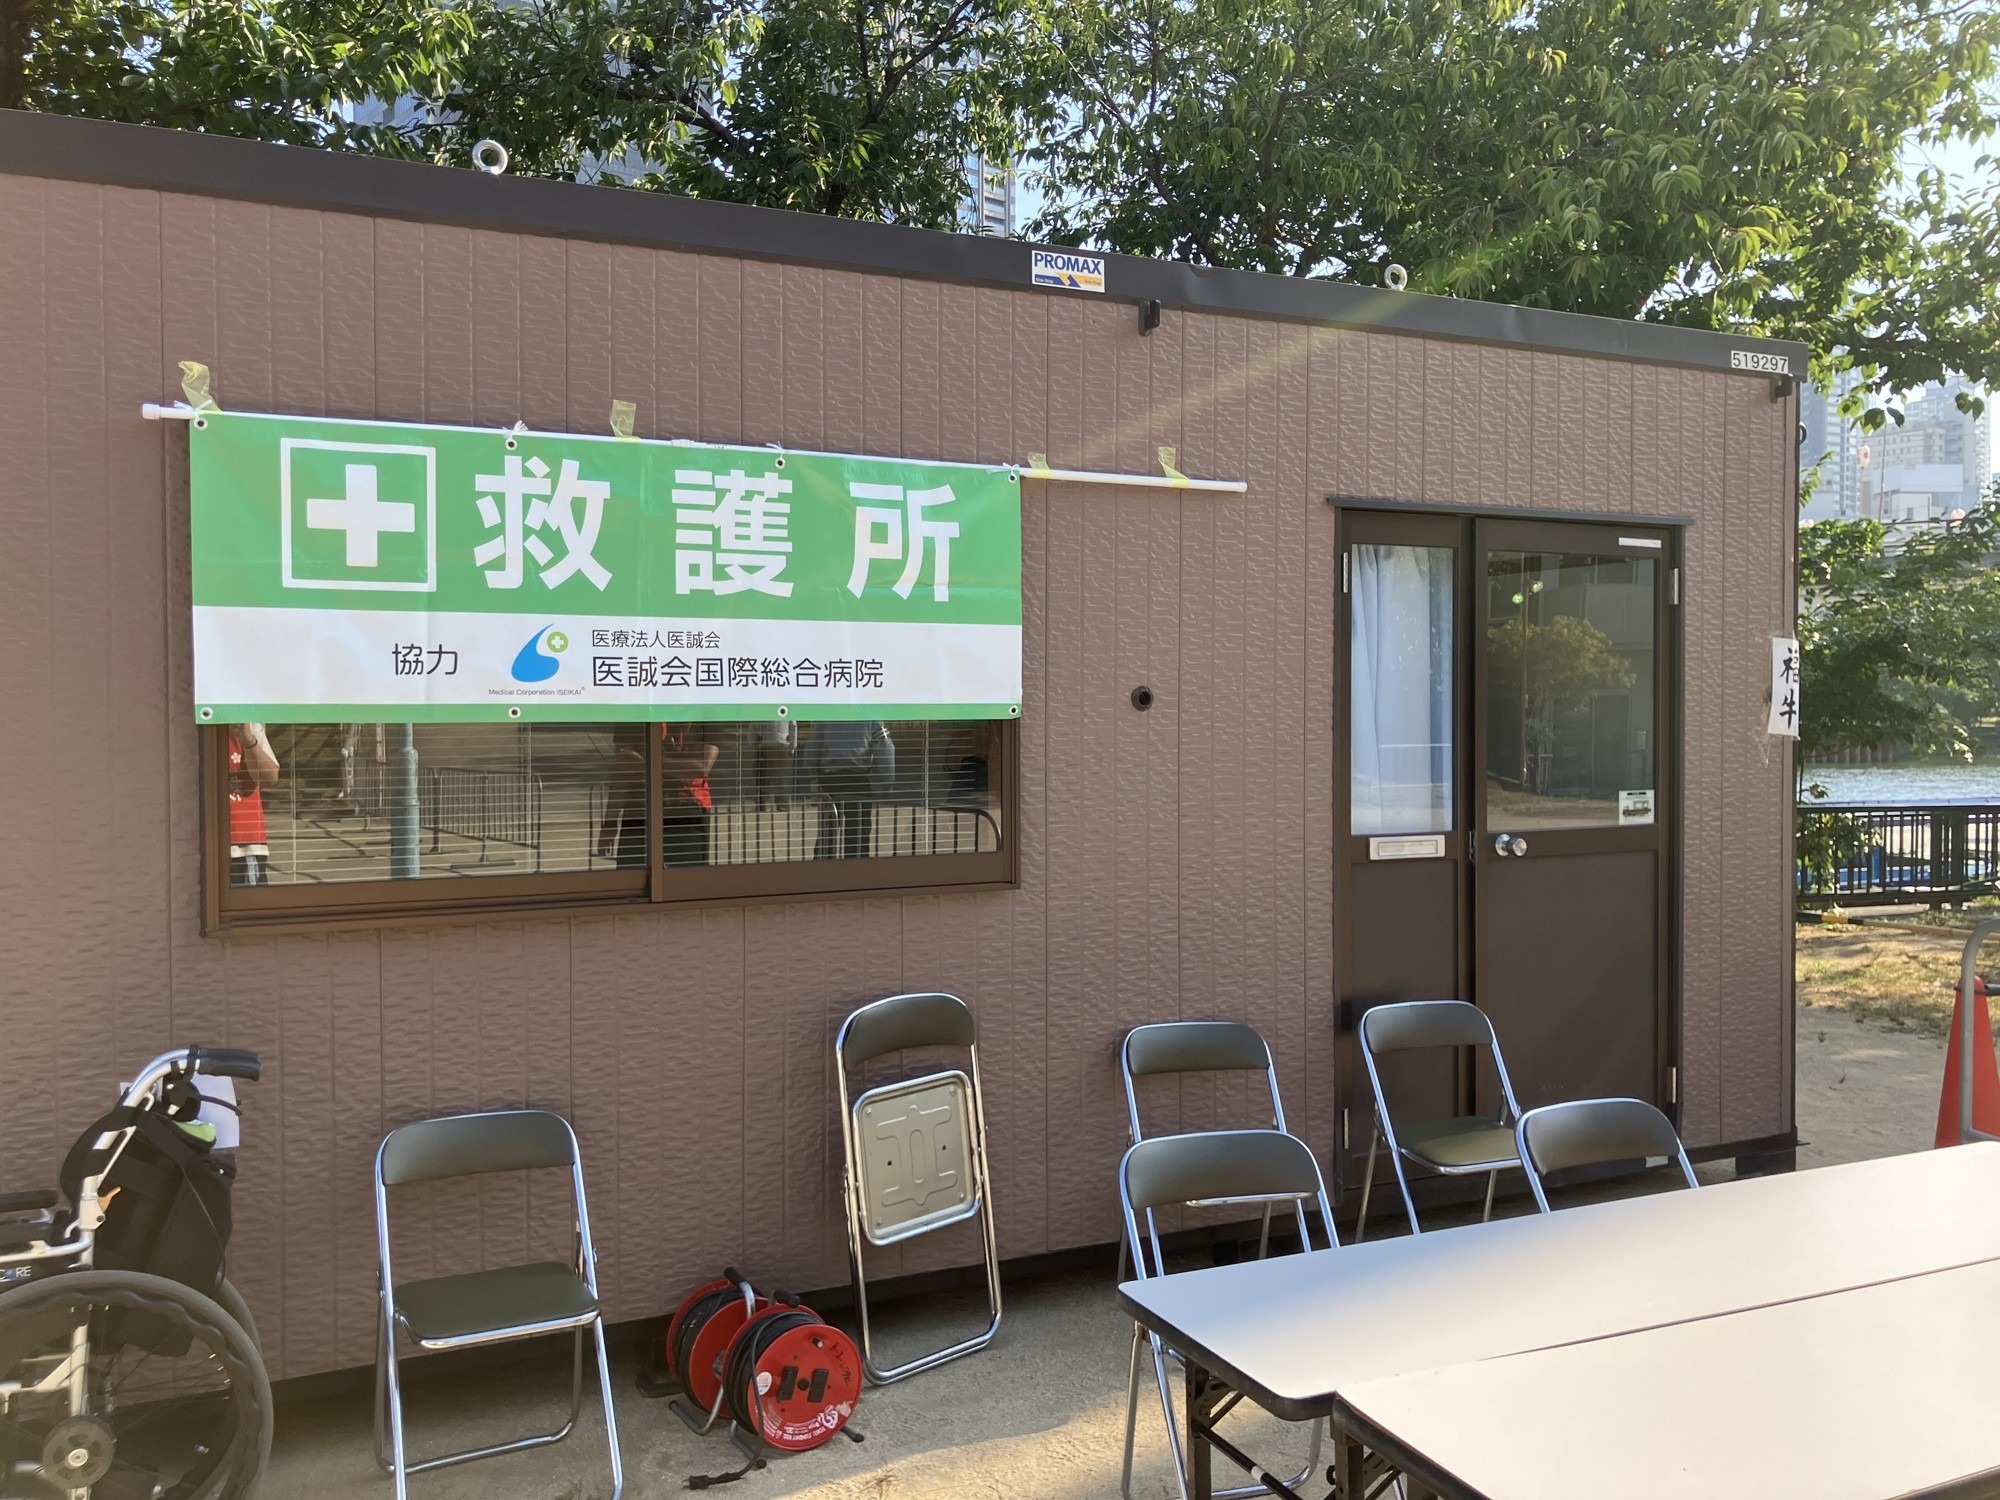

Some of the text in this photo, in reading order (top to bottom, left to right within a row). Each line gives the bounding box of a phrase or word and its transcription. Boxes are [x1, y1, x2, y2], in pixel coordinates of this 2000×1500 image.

[1034, 252, 1102, 275] PROMAX
[1733, 353, 1787, 372] 519297
[474, 457, 960, 602] 救護所
[592, 629, 720, 649] 医療法人医誠会
[392, 642, 458, 676] 協力
[593, 656, 883, 688] 医誠会国際総合病院
[488, 688, 515, 696] Medical
[516, 688, 555, 696] Corporation
